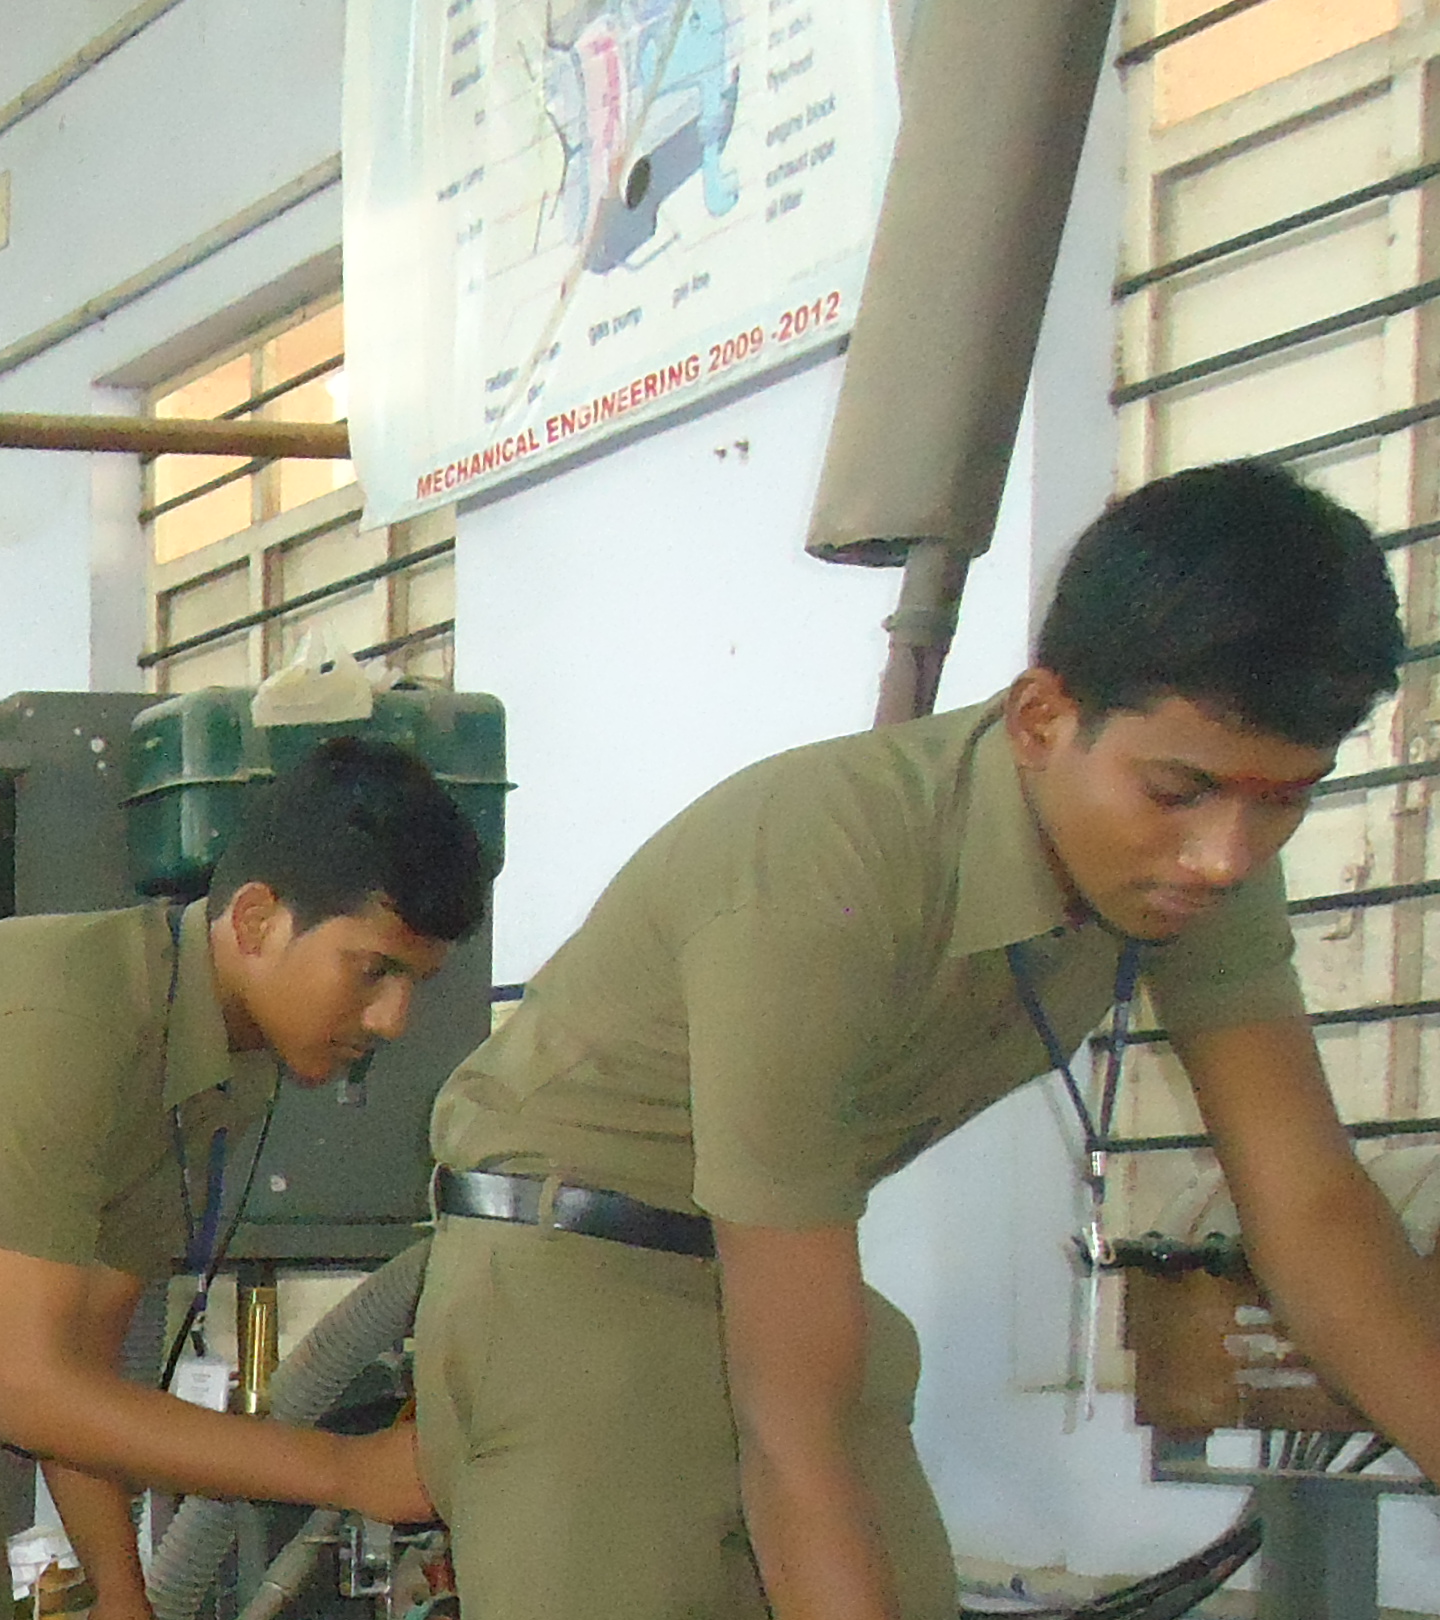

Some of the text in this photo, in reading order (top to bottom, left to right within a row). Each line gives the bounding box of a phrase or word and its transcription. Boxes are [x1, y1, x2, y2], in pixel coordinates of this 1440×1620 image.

[416, 427, 540, 500] MECHANICAL
[546, 354, 700, 444] ENGINEERING
[708, 326, 763, 373] 2009
